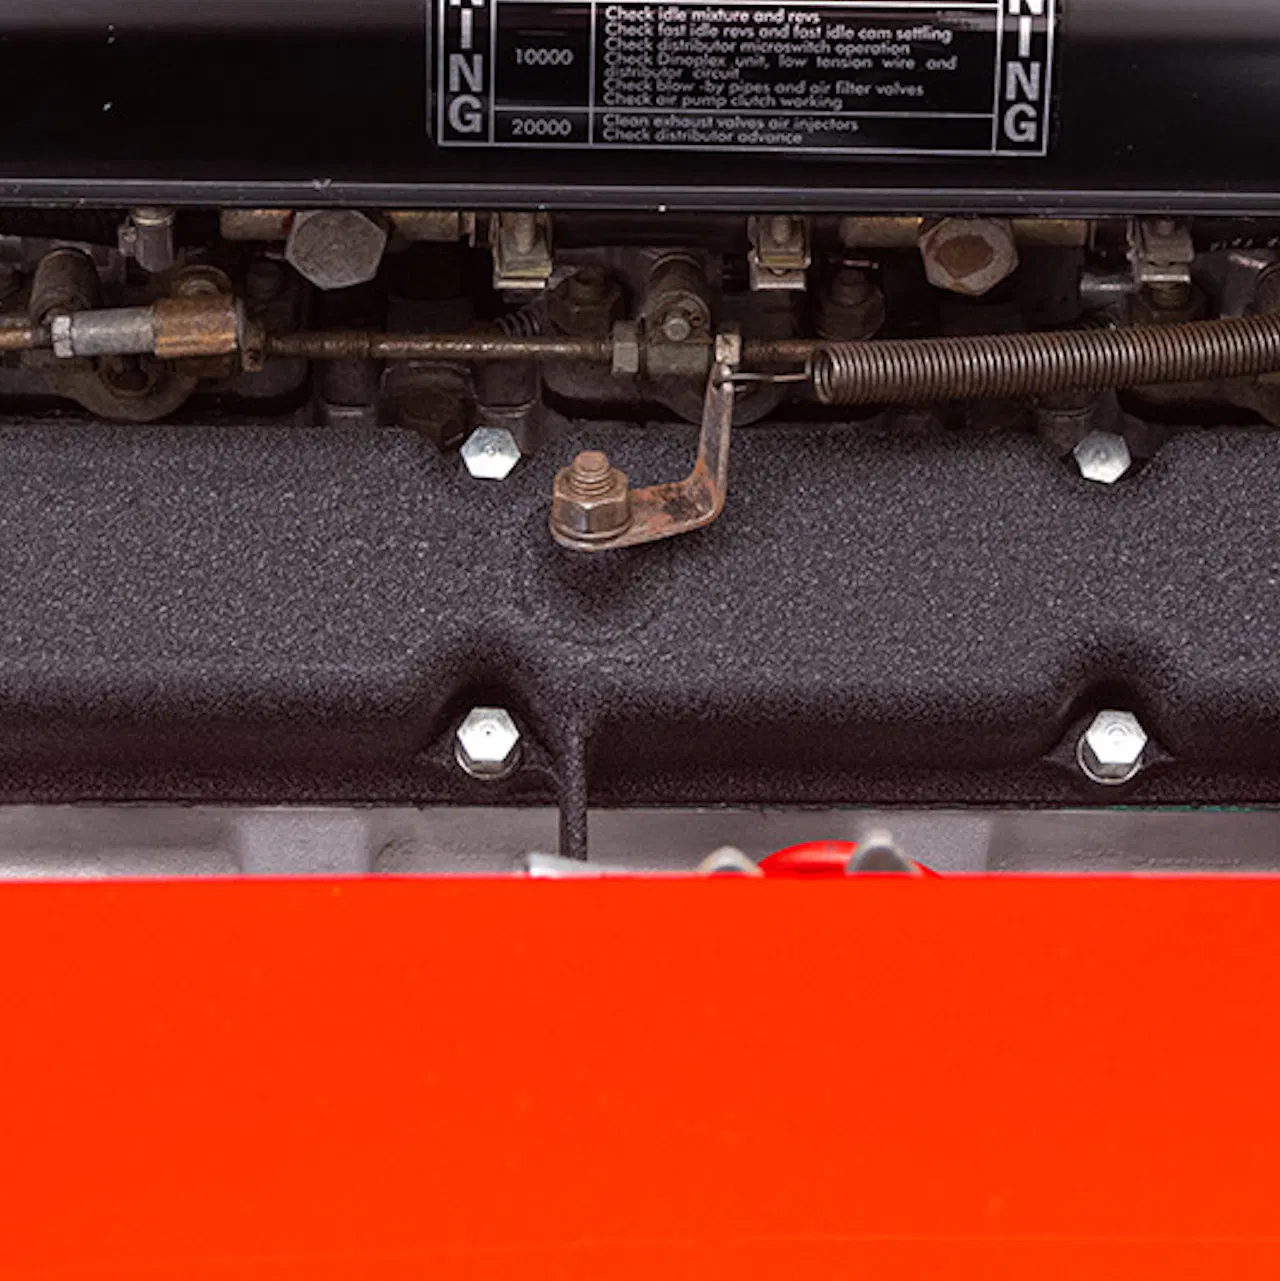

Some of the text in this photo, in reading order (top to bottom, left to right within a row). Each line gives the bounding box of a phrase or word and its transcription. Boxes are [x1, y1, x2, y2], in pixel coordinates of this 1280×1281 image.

[605, 5, 821, 24] Check idle mixture and revs
[605, 21, 654, 37] Check
[658, 21, 687, 37] fast
[689, 22, 720, 38] idle
[723, 26, 754, 39] revs
[758, 23, 790, 39] and
[793, 23, 822, 40] fast
[825, 23, 856, 40] idle
[857, 27, 893, 40] cam
[604, 36, 911, 56] Check distributor microswitch operation
[515, 48, 574, 66] 10000
[604, 51, 654, 66] Check
[656, 51, 726, 67] Dinoplex
[778, 53, 809, 69] low
[816, 55, 873, 70] tension
[881, 55, 916, 70] wire
[925, 55, 958, 71] and
[603, 78, 654, 93] Check
[728, 79, 770, 96] pipes
[773, 80, 807, 95] and
[809, 80, 832, 95] air
[835, 79, 871, 96] filter
[874, 80, 925, 96] valves
[603, 92, 844, 111] Check air pump clutch working
[511, 118, 572, 137] 20000
[603, 113, 860, 133] Clean exhaust valves air injectors
[603, 128, 803, 145] Check distributor advance
